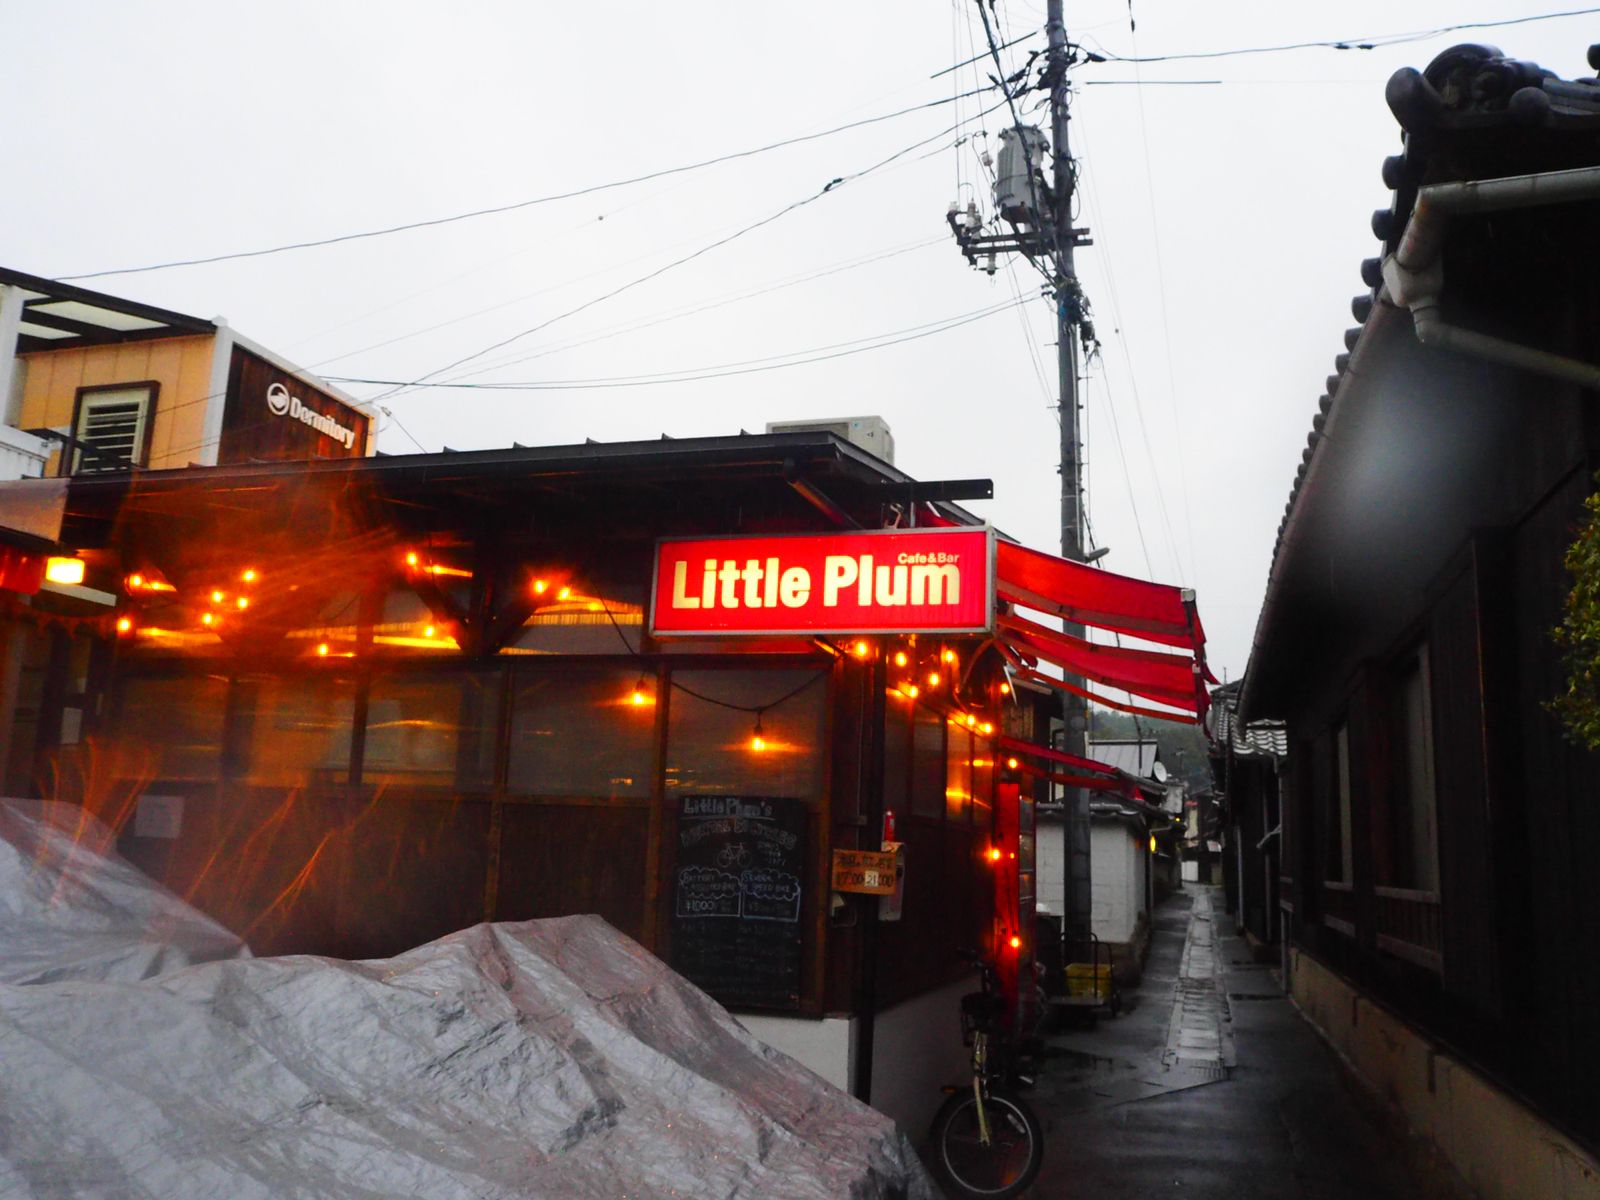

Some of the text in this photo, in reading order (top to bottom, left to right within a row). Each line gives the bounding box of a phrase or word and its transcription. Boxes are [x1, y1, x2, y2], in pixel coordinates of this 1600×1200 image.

[897, 552, 960, 564] Cafe&Bar
[672, 554, 961, 609] Little Plum
